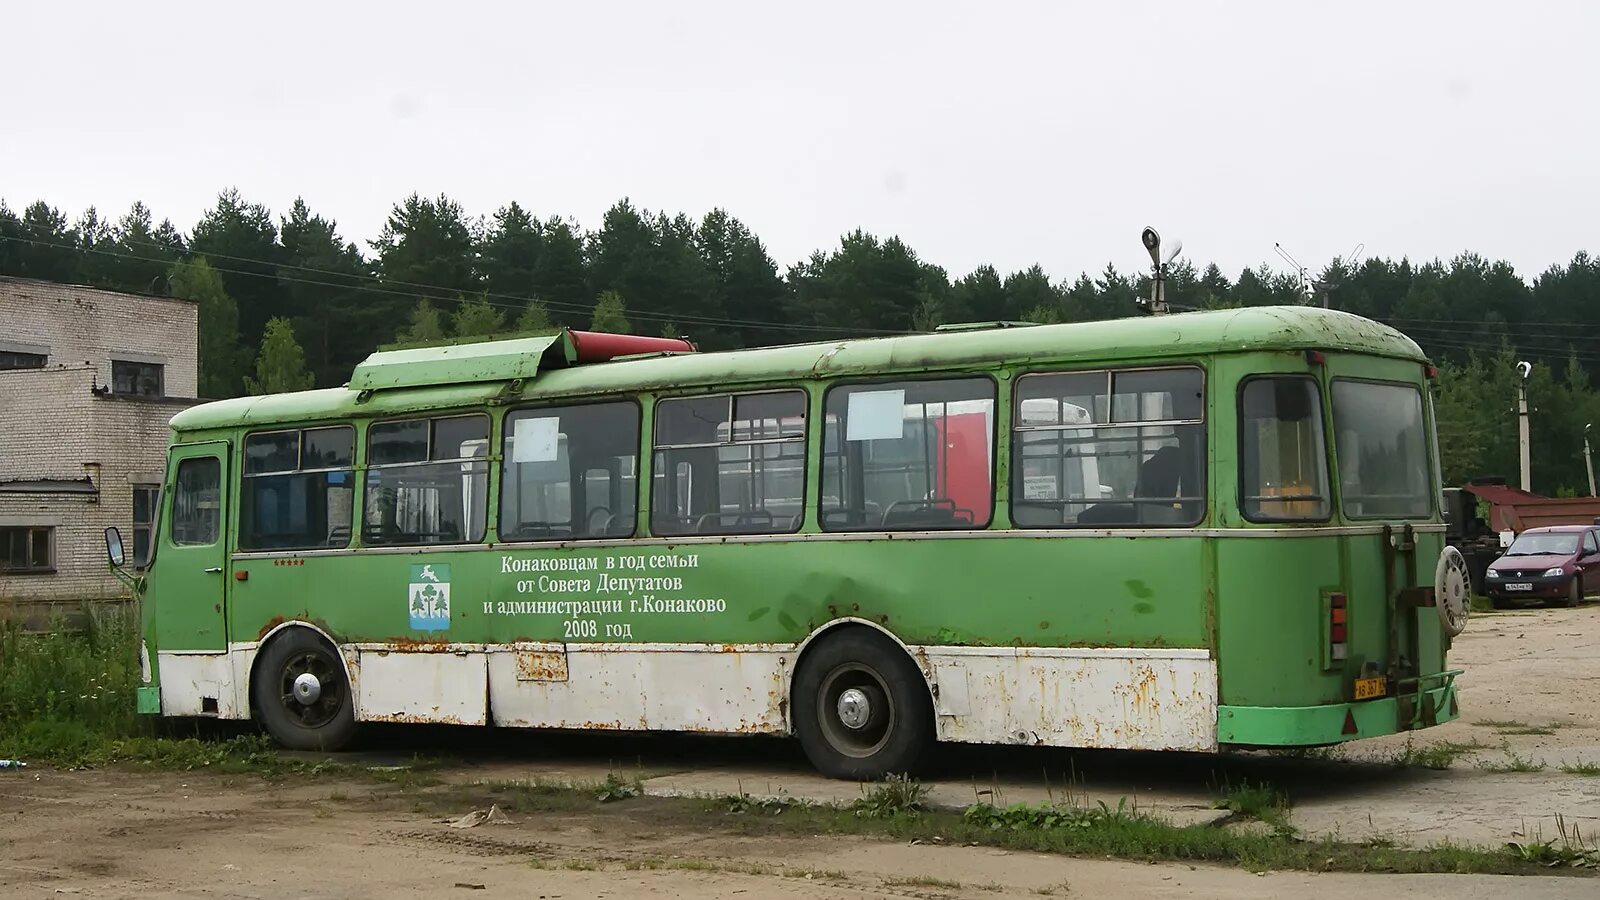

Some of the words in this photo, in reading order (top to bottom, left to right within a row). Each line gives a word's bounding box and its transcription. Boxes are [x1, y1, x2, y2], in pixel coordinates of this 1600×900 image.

[501, 556, 598, 573] Конаковцам
[605, 556, 615, 569] в
[619, 555, 646, 571] год
[649, 554, 698, 569] семьи
[516, 579, 536, 593] от
[538, 575, 591, 593] Совета
[596, 573, 683, 595] Депутатов
[483, 601, 493, 614] и
[497, 599, 623, 619] администрации
[629, 594, 726, 613] г.Конаково
[563, 619, 598, 638] 2008
[605, 623, 633, 639] год
